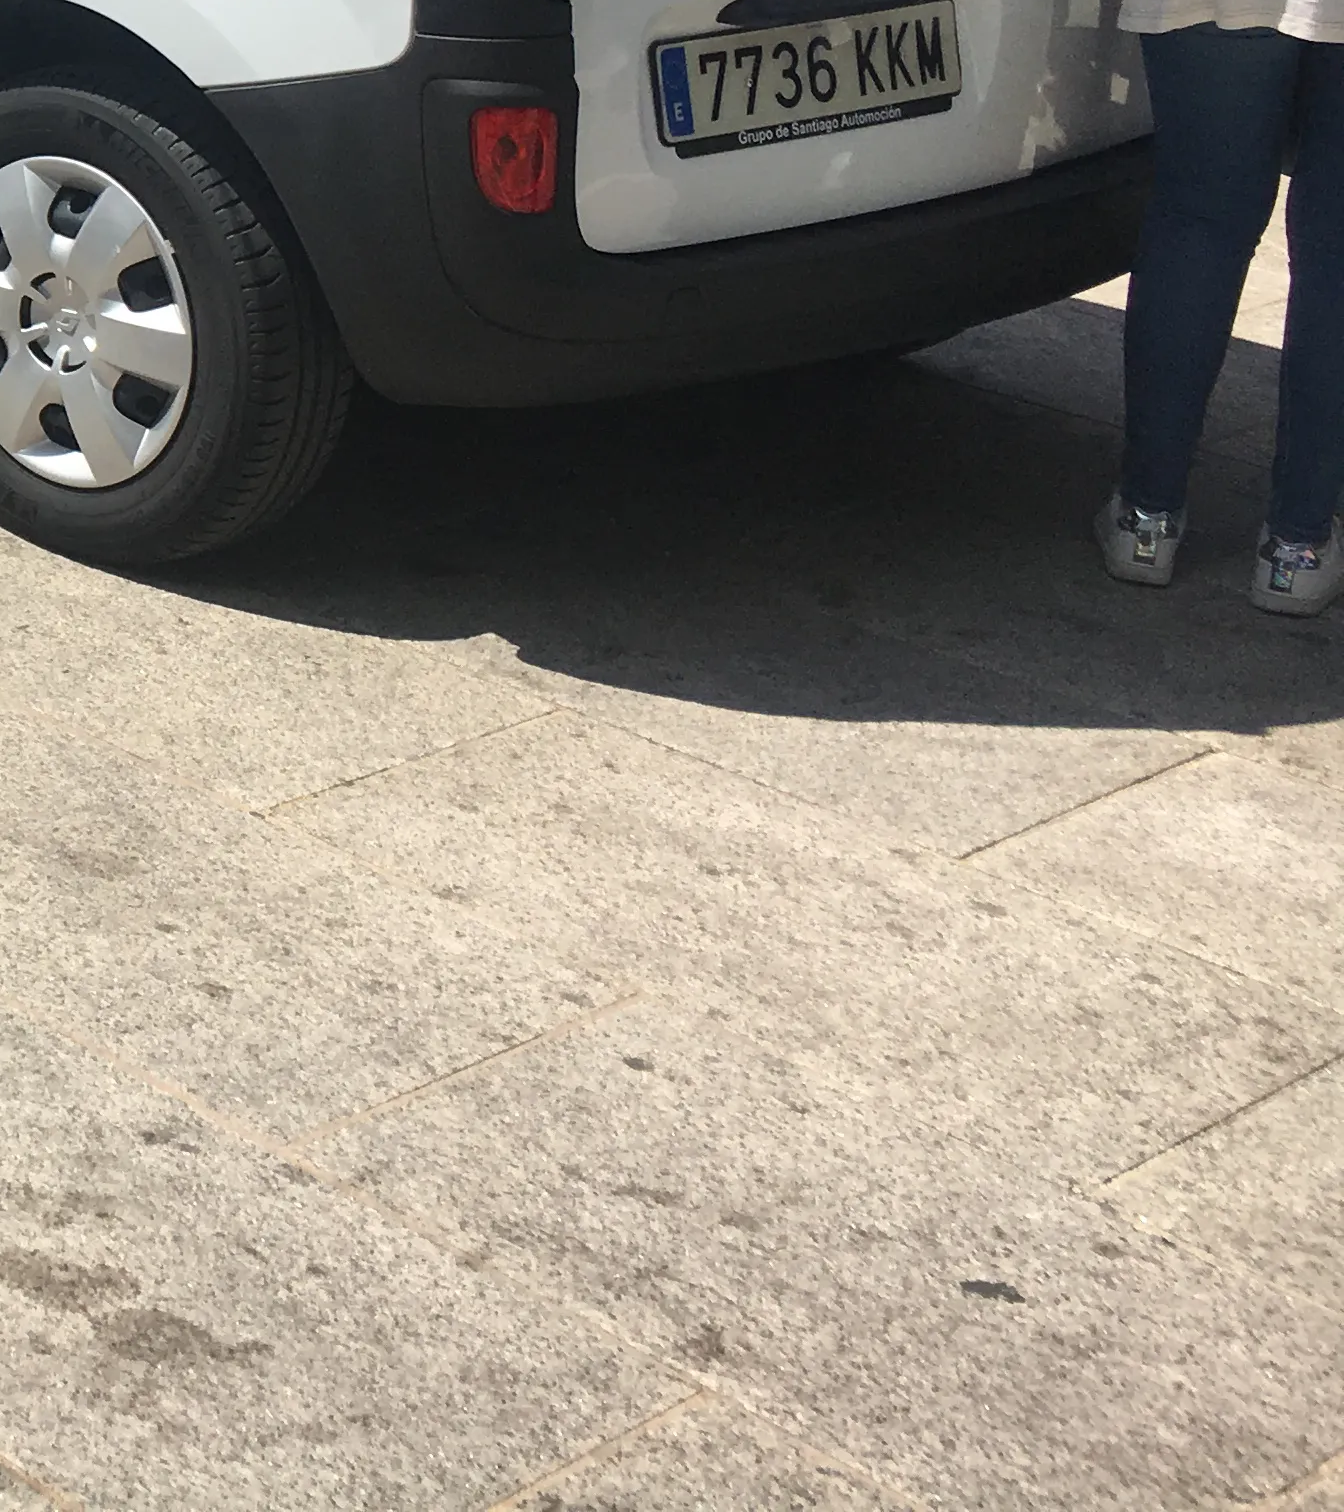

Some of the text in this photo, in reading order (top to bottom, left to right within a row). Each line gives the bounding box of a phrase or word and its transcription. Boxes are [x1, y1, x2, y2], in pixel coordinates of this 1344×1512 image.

[698, 17, 946, 122] 7736 KKM
[673, 102, 685, 122] E
[738, 106, 902, 146] Grupo de Santiago Automoción
